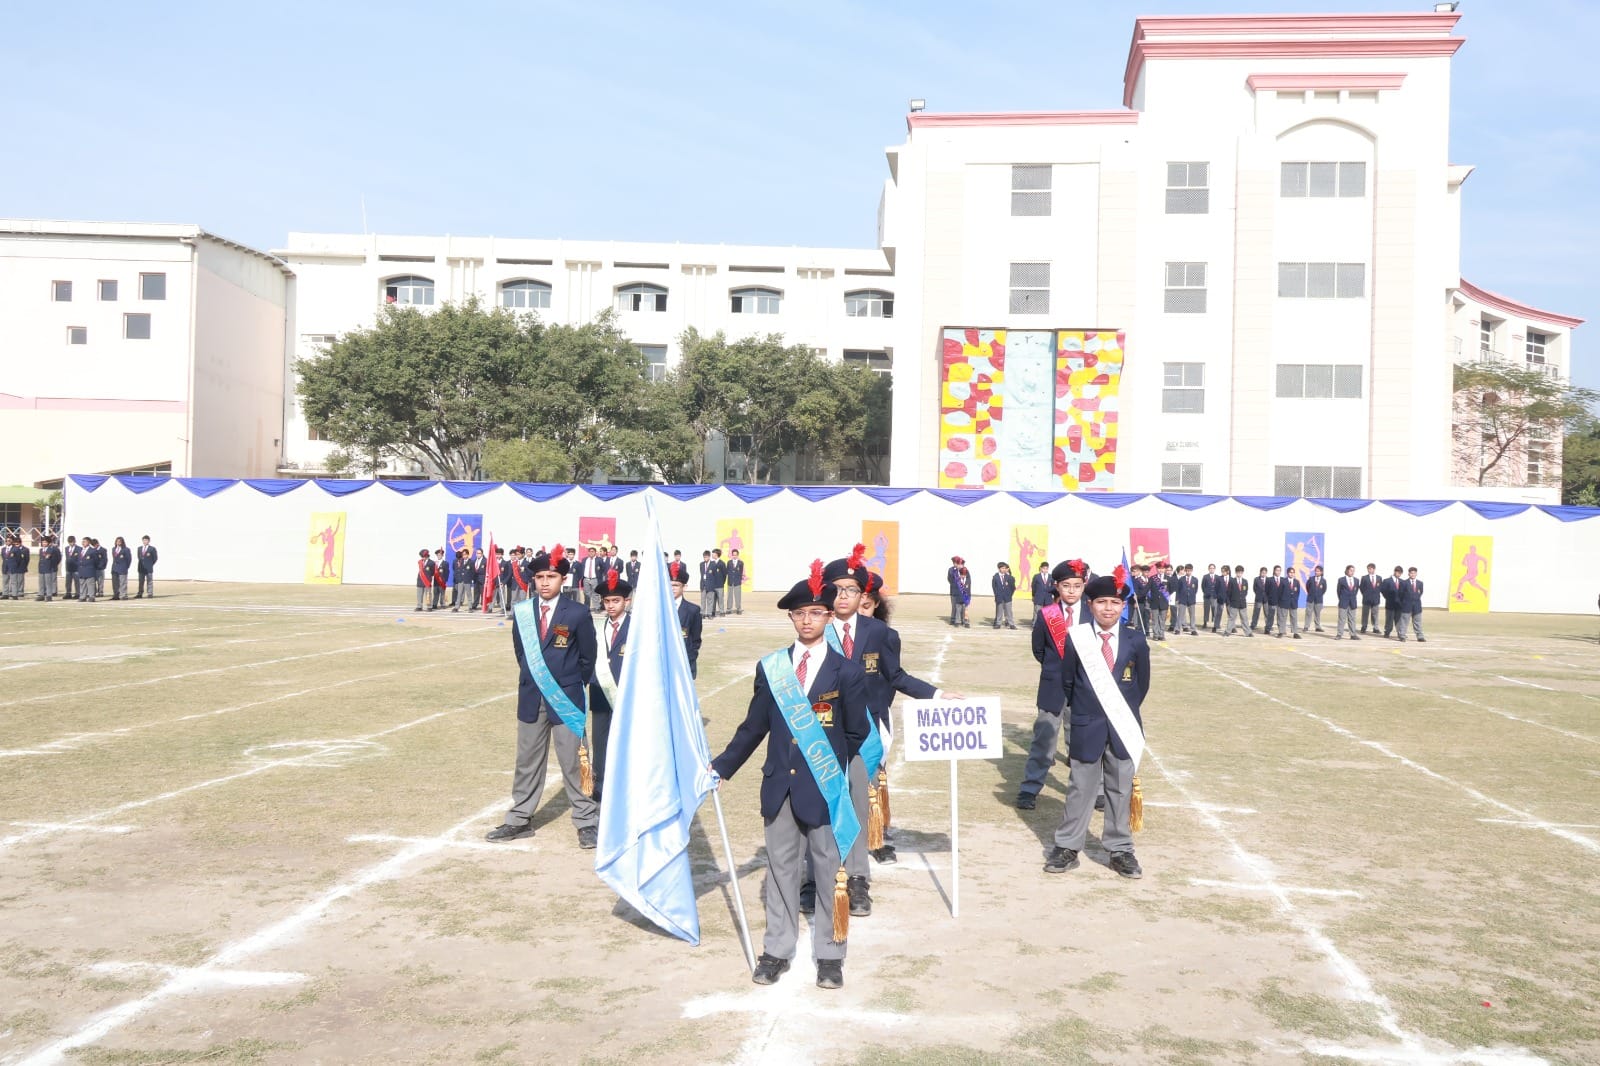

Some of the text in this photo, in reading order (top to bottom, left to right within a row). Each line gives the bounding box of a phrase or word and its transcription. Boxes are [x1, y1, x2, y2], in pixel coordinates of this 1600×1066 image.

[917, 706, 987, 727] MAYOOR
[772, 676, 815, 731] HEAD
[806, 741, 841, 793] GIRL
[919, 730, 988, 752] SCHOOL
